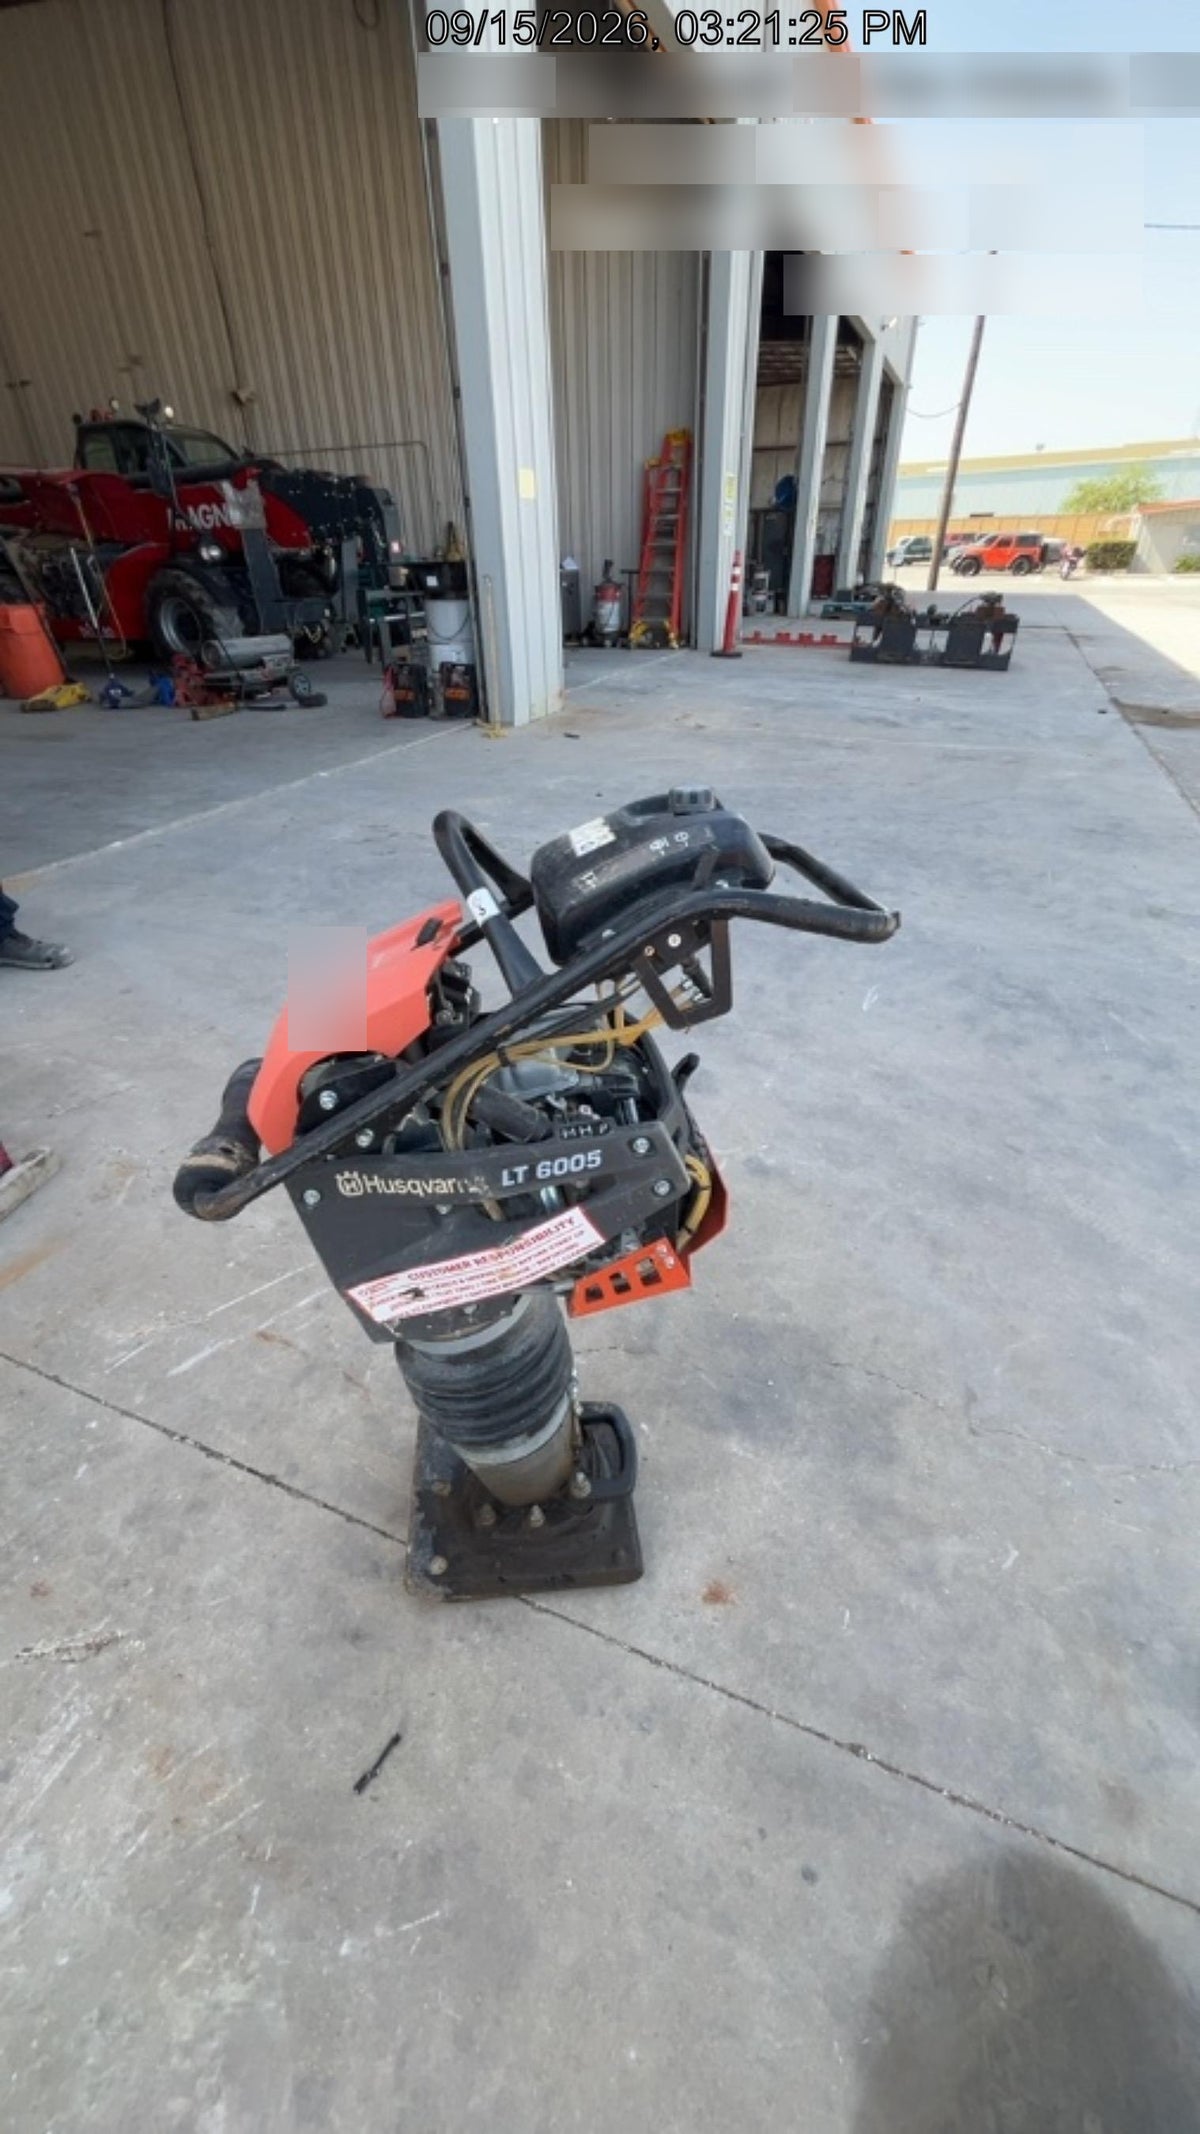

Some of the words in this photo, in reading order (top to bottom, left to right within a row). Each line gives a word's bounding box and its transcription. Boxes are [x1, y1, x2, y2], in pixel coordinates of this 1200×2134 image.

[502, 1165, 529, 1187] LT
[536, 1149, 602, 1180] 6005
[407, 1260, 473, 1282] CUSTOMER
[474, 1216, 575, 1267] RESPONSIBILITY
